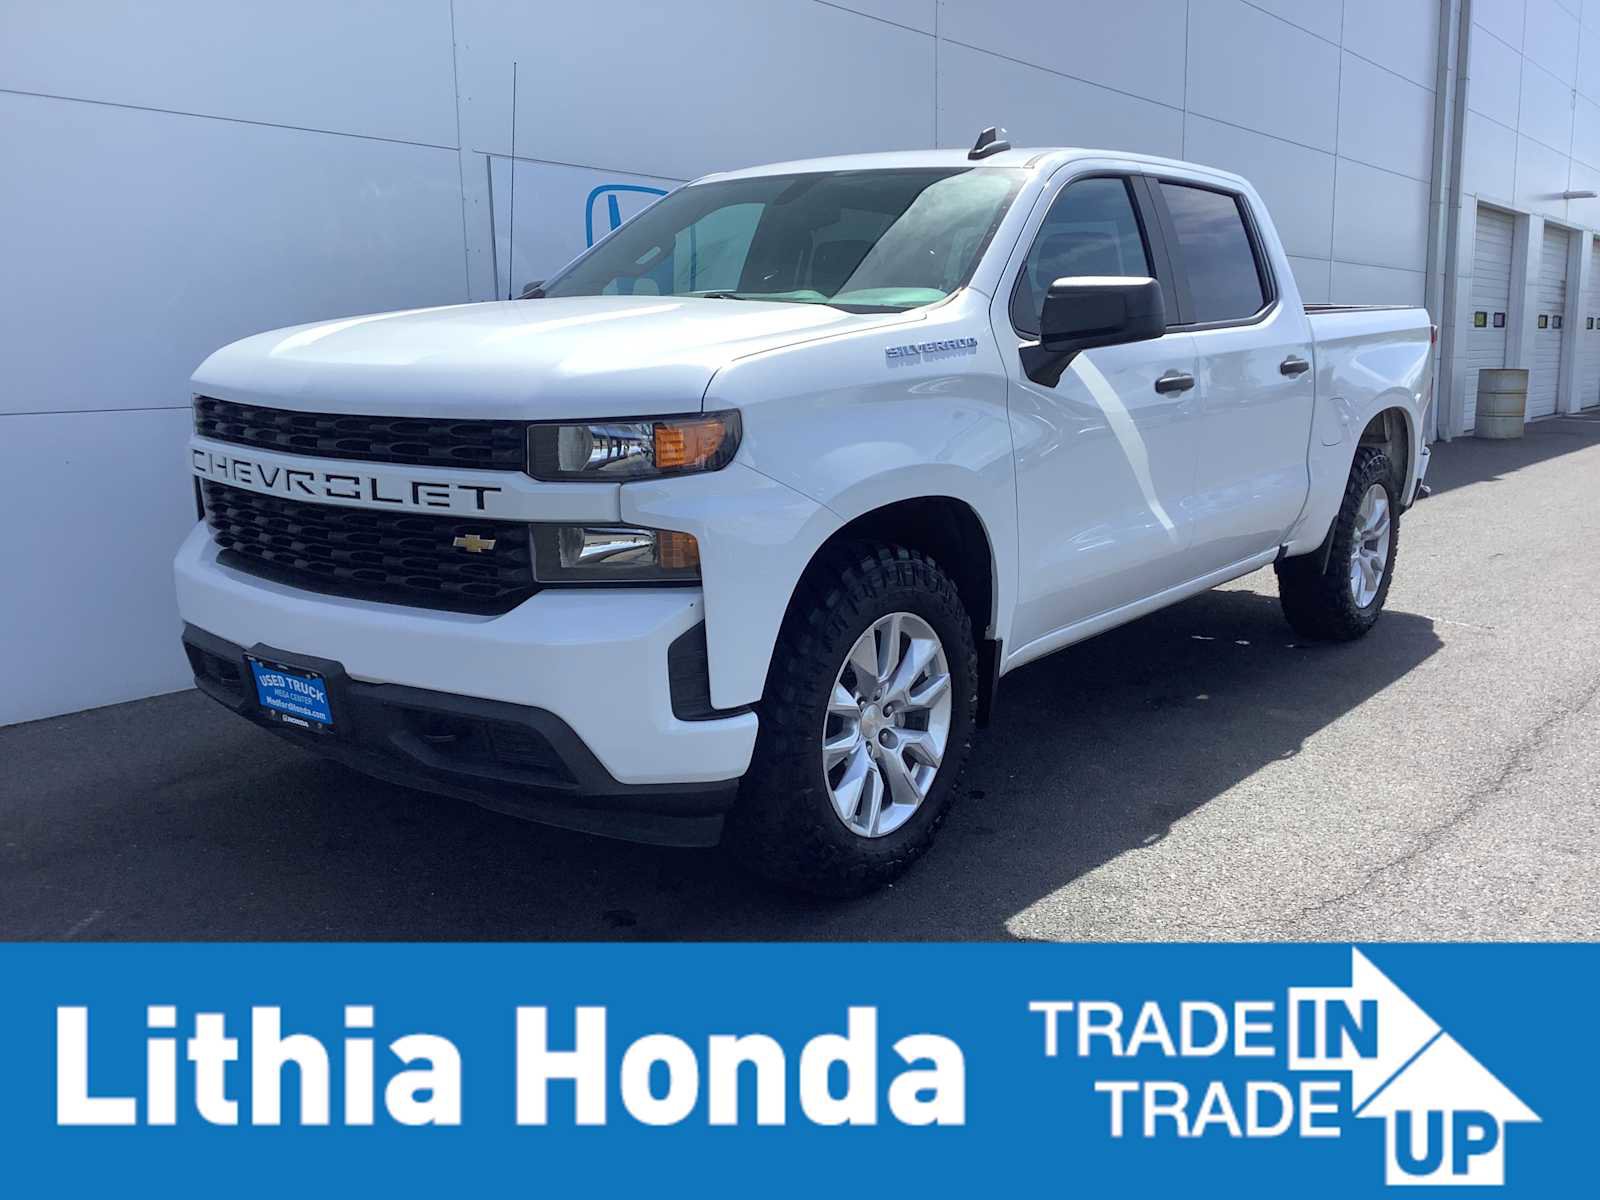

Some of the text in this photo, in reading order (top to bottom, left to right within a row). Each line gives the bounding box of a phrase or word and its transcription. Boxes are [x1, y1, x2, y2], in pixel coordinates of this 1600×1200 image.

[885, 337, 978, 358] SILVERADO
[192, 449, 502, 510] CHEVROLET
[259, 674, 325, 704] USED TRUCK
